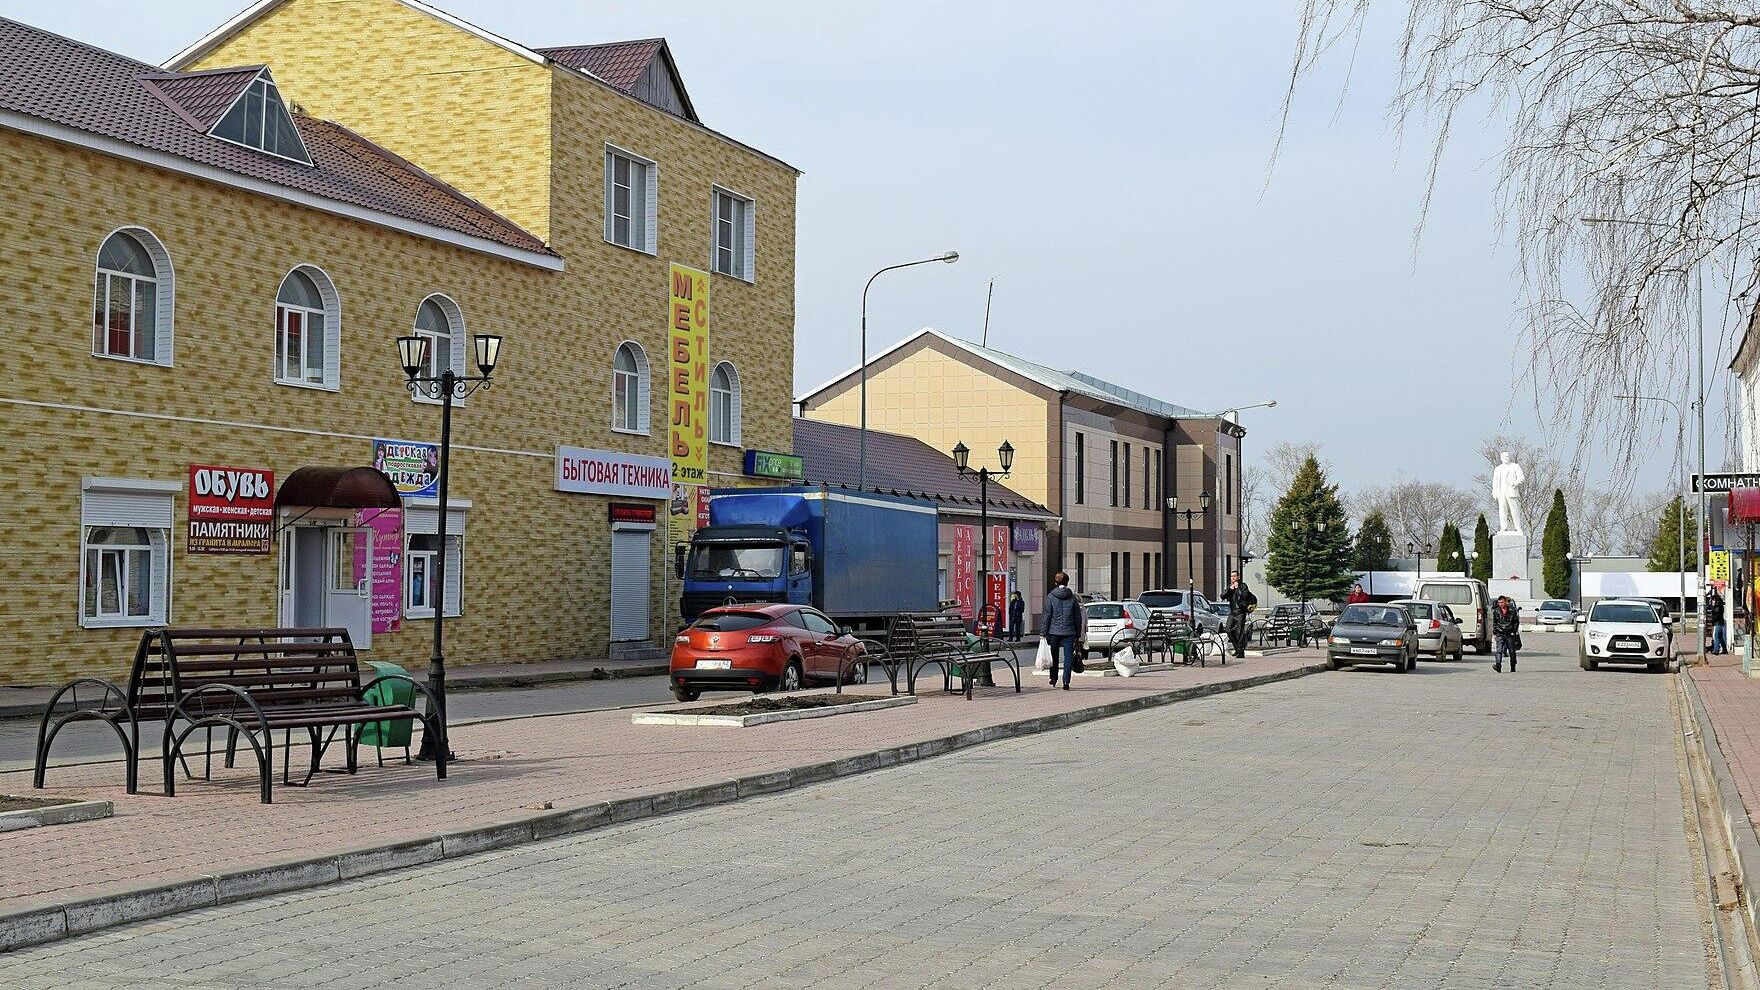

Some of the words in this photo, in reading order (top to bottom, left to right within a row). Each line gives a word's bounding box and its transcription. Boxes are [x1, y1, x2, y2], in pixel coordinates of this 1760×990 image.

[672, 271, 692, 458] МЕБЕЛЬ
[694, 298, 707, 439] СТИЛЬ
[194, 469, 269, 502] ОБУВЬ
[563, 457, 618, 485] БЫТОВАЯ
[621, 463, 670, 489] ТЕХНИКА
[672, 462, 678, 478] 2
[681, 464, 704, 479] этаж
[193, 504, 220, 515] мужская
[221, 506, 248, 515] женская
[249, 508, 273, 517] детская
[190, 522, 269, 539] ПАМЯТНИКИ
[964, 529, 972, 607] АЛИСА
